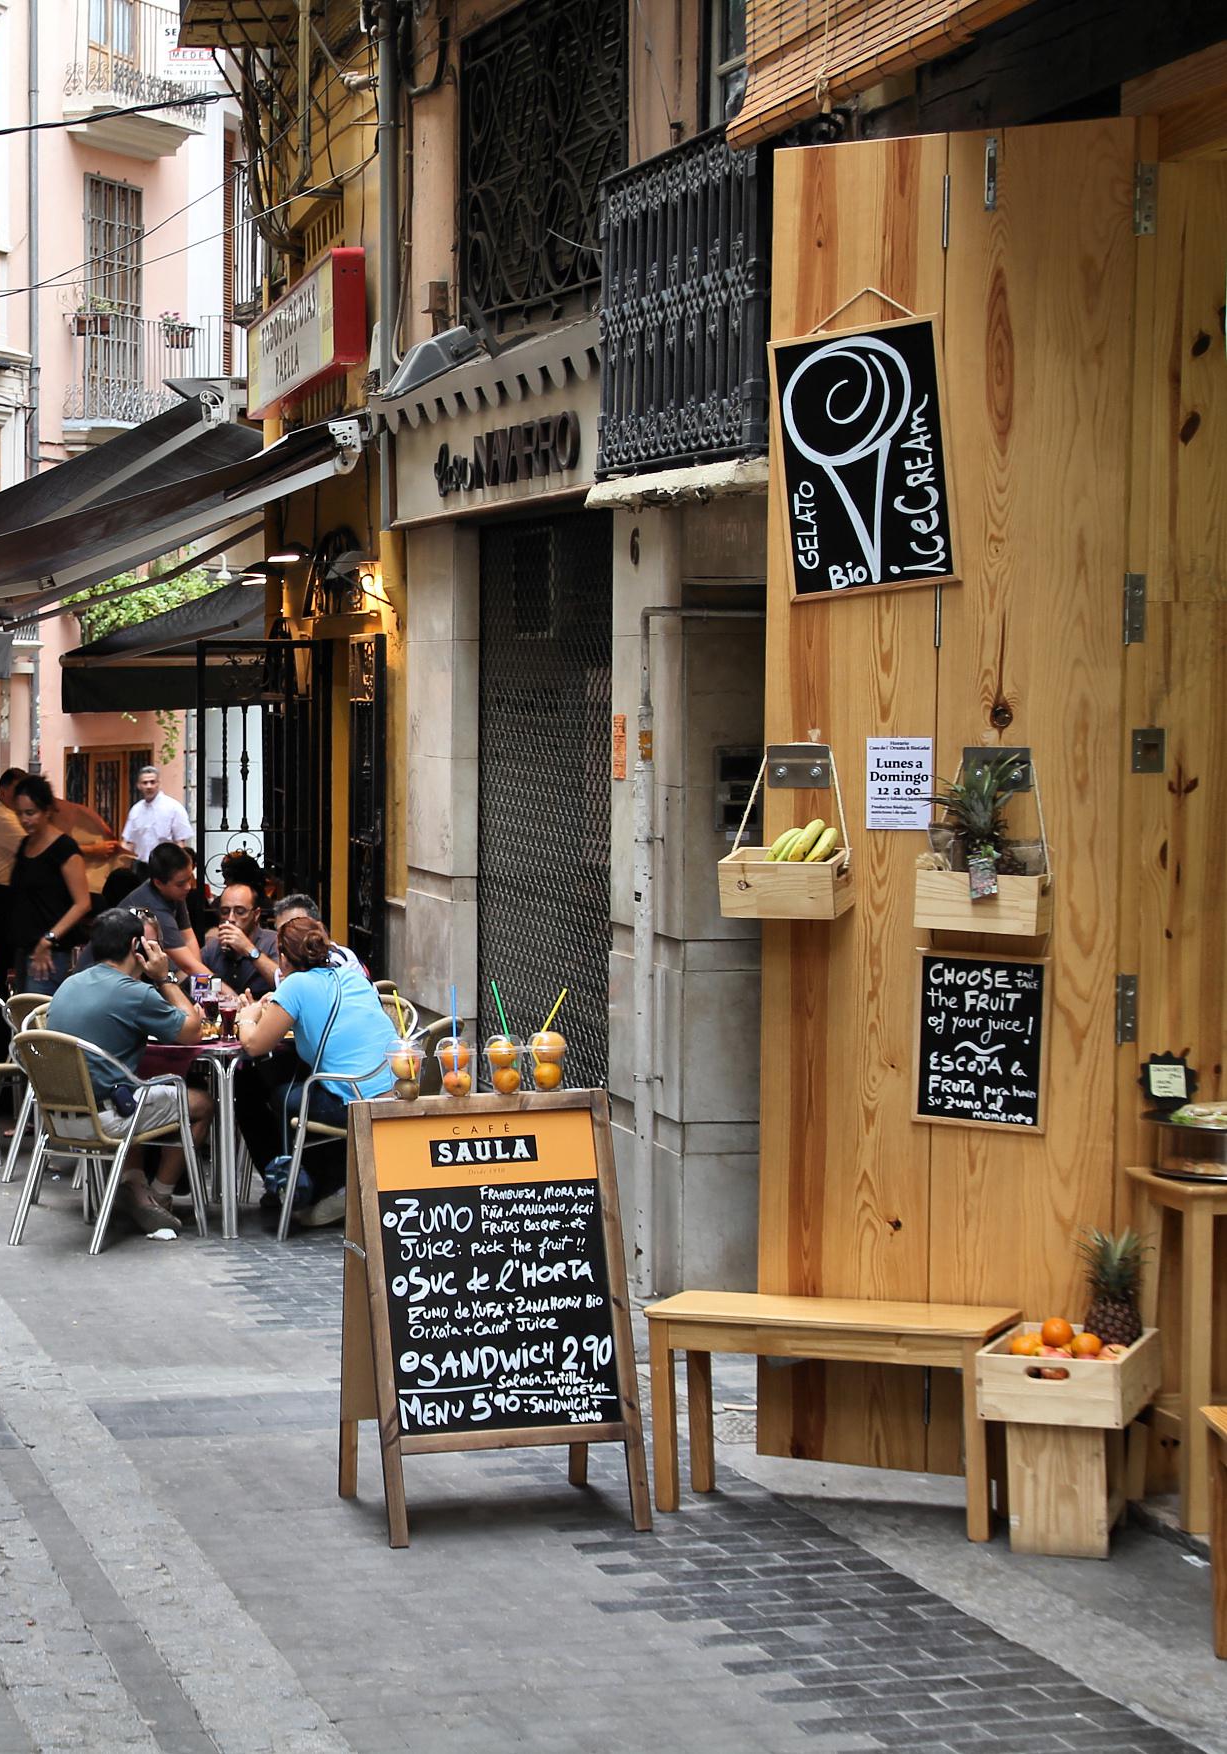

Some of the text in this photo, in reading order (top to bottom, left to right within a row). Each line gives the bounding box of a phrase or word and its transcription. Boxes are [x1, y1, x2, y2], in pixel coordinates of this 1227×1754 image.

[275, 342, 300, 387] PAELLA
[793, 480, 820, 570] GELATO
[629, 527, 640, 567] 6
[828, 561, 868, 590] Bio
[876, 757, 923, 768] Lunes a
[870, 770, 929, 785] Domingo
[877, 787, 889, 795] 12
[893, 788, 901, 796] a
[929, 962, 1013, 990] CHOOSE
[926, 987, 958, 1009] the
[927, 1011, 946, 1035] of
[951, 1016, 984, 1035] your
[1010, 1060, 1028, 1078] la
[983, 1085, 1011, 1103] para
[987, 1095, 1004, 1113] al
[972, 1110, 1033, 1125] momento
[437, 1138, 532, 1163] SAULA
[470, 1240, 505, 1257] pick
[511, 1237, 533, 1256] the
[538, 1235, 574, 1259] fruit
[466, 1266, 491, 1294] de
[473, 1319, 512, 1337] Carrot
[561, 1334, 613, 1376] 2,90
